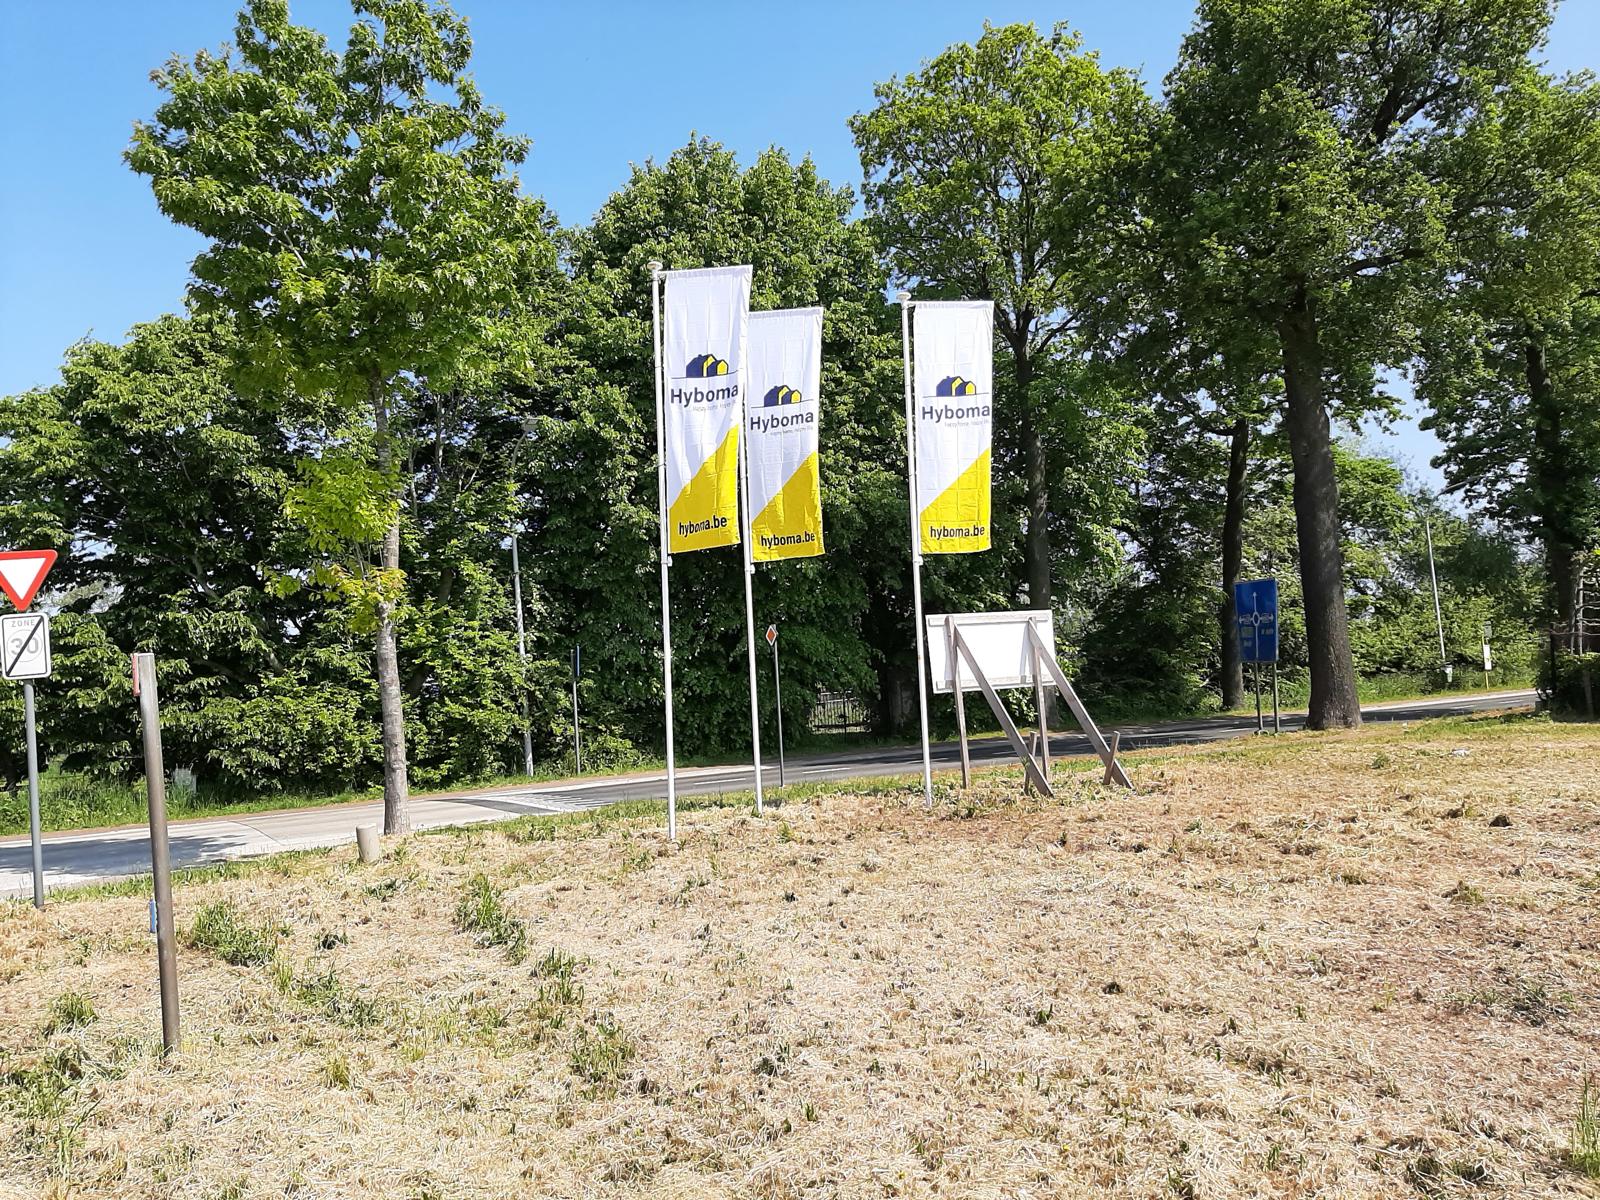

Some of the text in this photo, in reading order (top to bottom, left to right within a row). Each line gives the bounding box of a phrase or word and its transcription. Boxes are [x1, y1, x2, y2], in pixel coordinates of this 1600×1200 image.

[671, 384, 739, 408] Hyboma
[750, 411, 814, 434] Hyboma
[922, 404, 990, 424] Hyboma
[679, 514, 728, 538] hyboma.be
[930, 525, 985, 540] hyboma.be
[761, 530, 816, 549] hyboma.be
[11, 619, 36, 628] ZONE
[10, 637, 39, 656] 30
